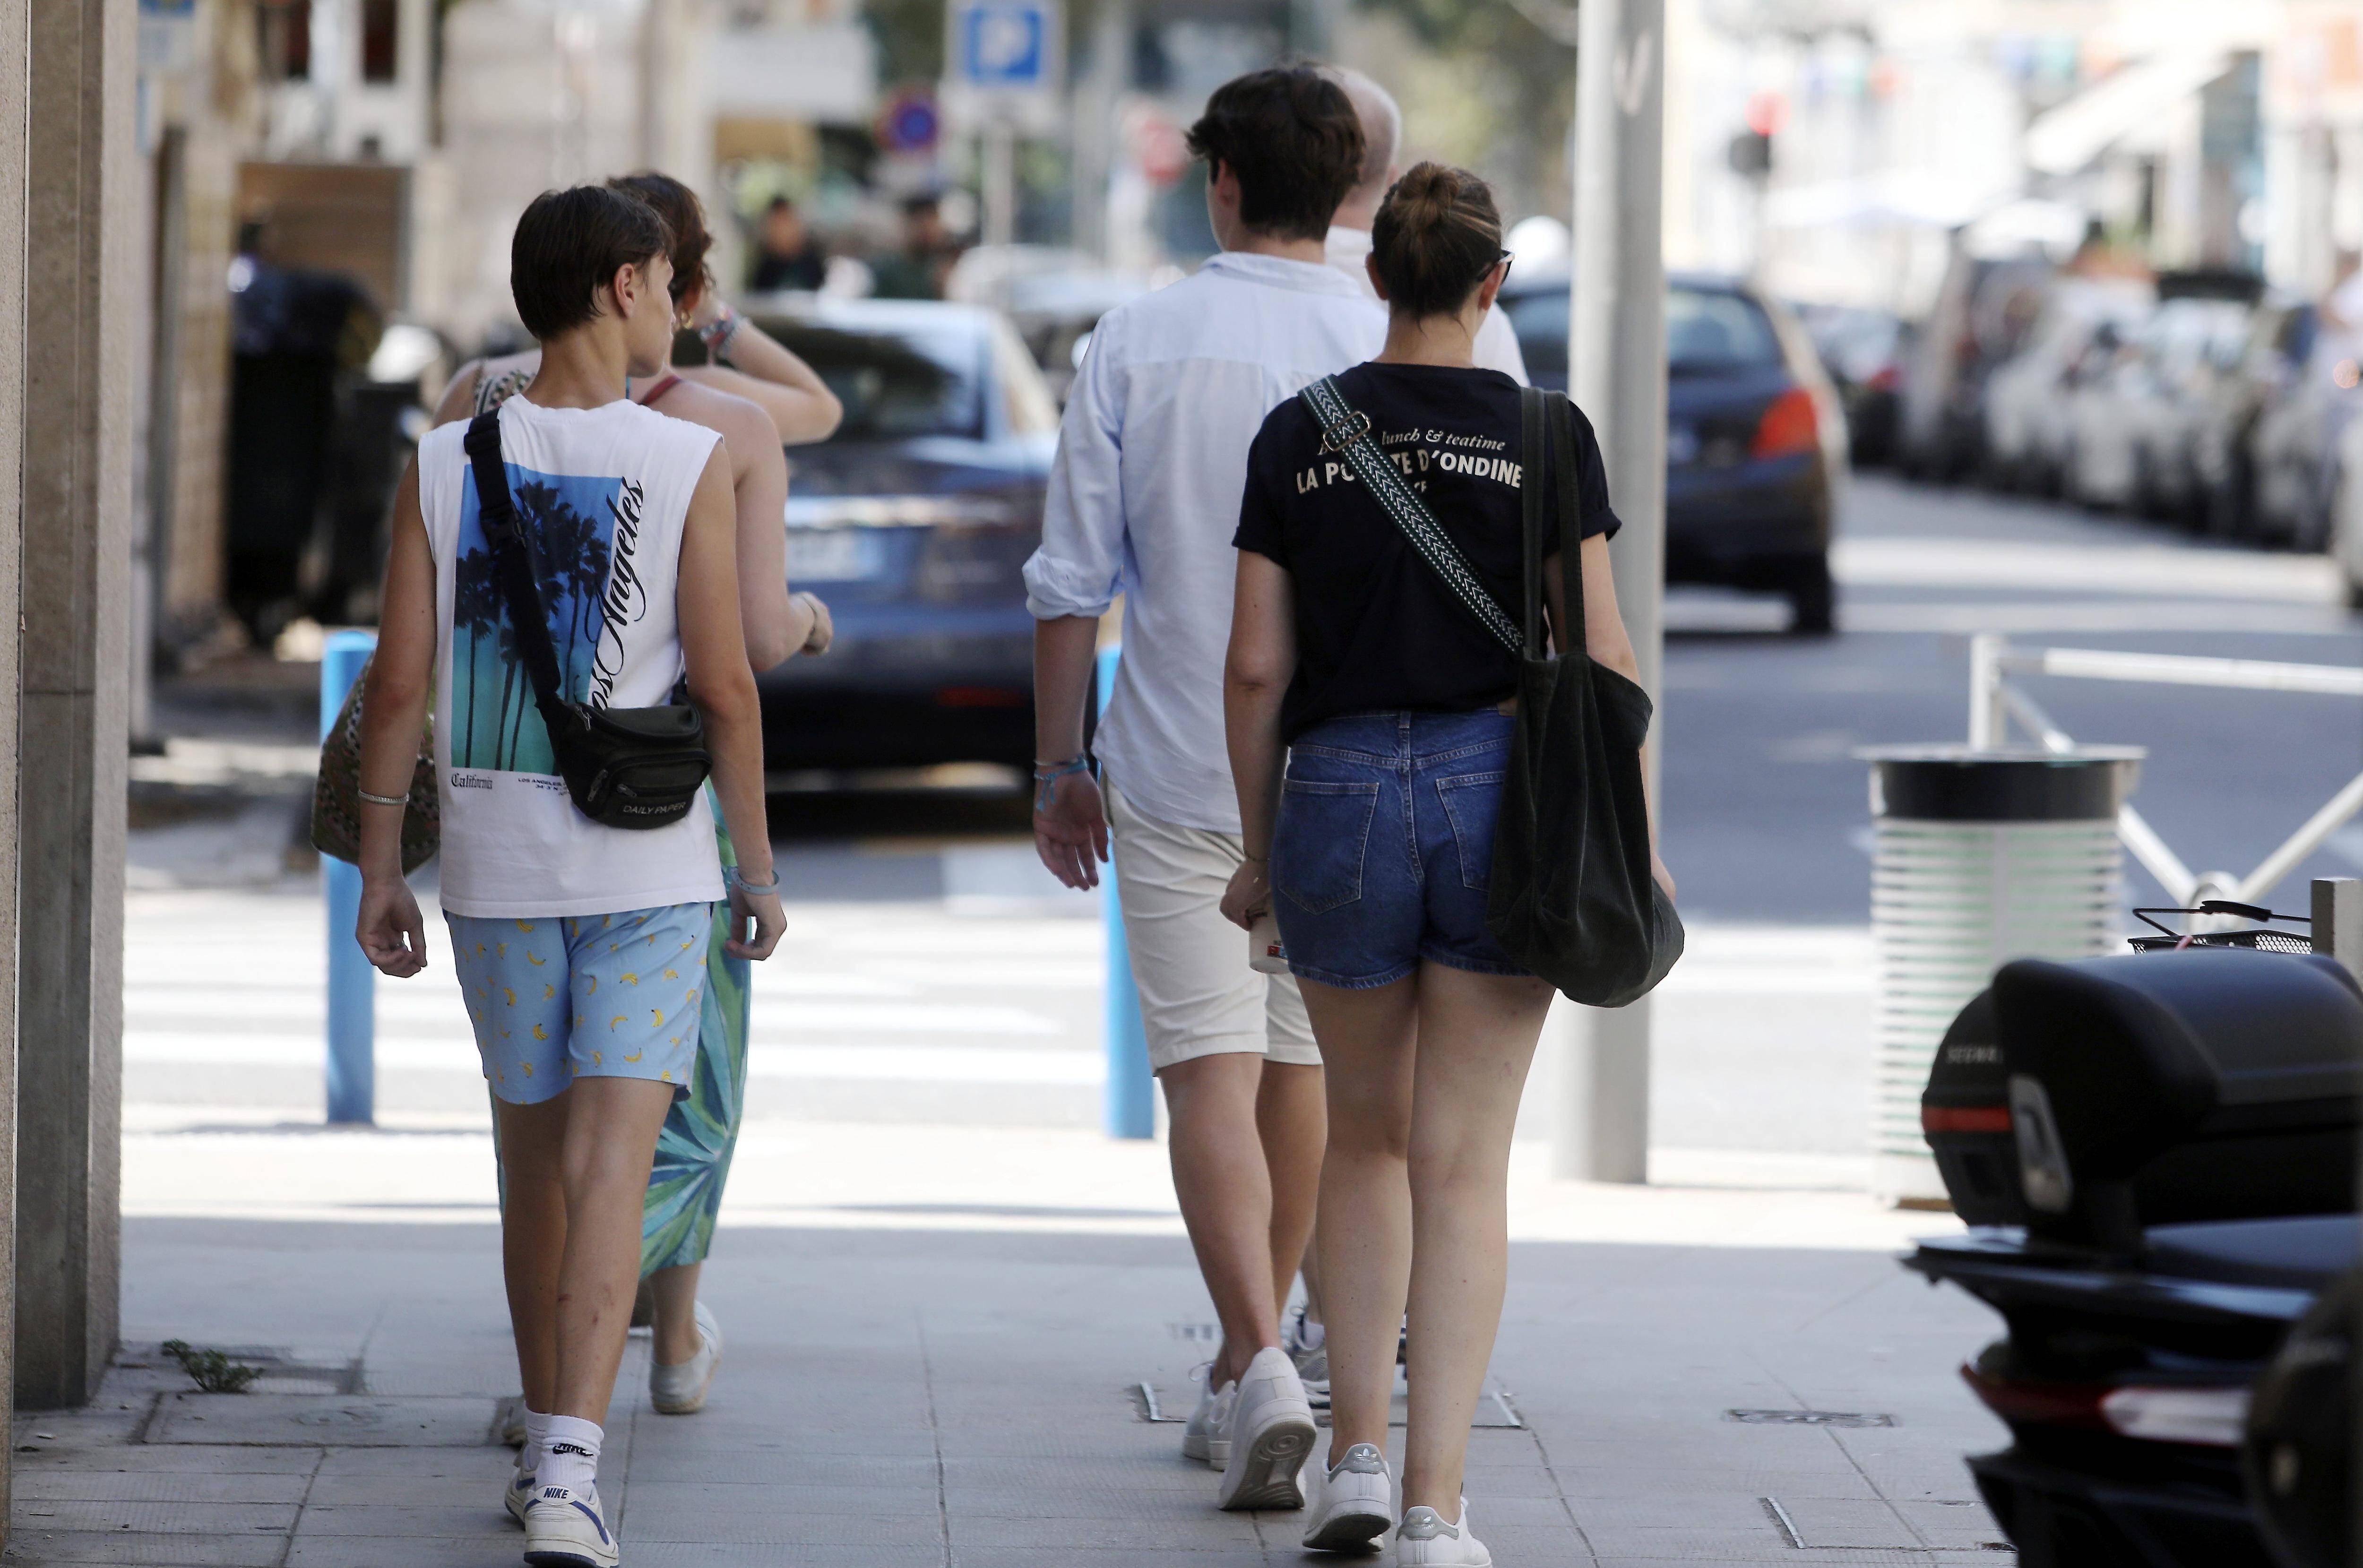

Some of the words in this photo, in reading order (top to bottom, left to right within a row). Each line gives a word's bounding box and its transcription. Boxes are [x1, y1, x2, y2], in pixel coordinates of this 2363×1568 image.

[1381, 428, 1420, 446] lunch
[1425, 429, 1444, 443] &
[1445, 432, 1506, 451] teatime
[1296, 467, 1319, 494] LA
[1417, 449, 1523, 489] D'ONDINE
[584, 476, 646, 676] Angeles
[574, 666, 613, 711] os
[451, 773, 493, 790] California
[623, 805, 655, 814] DAILY
[654, 801, 686, 814] PAPER
[543, 1487, 569, 1499] NIKE
